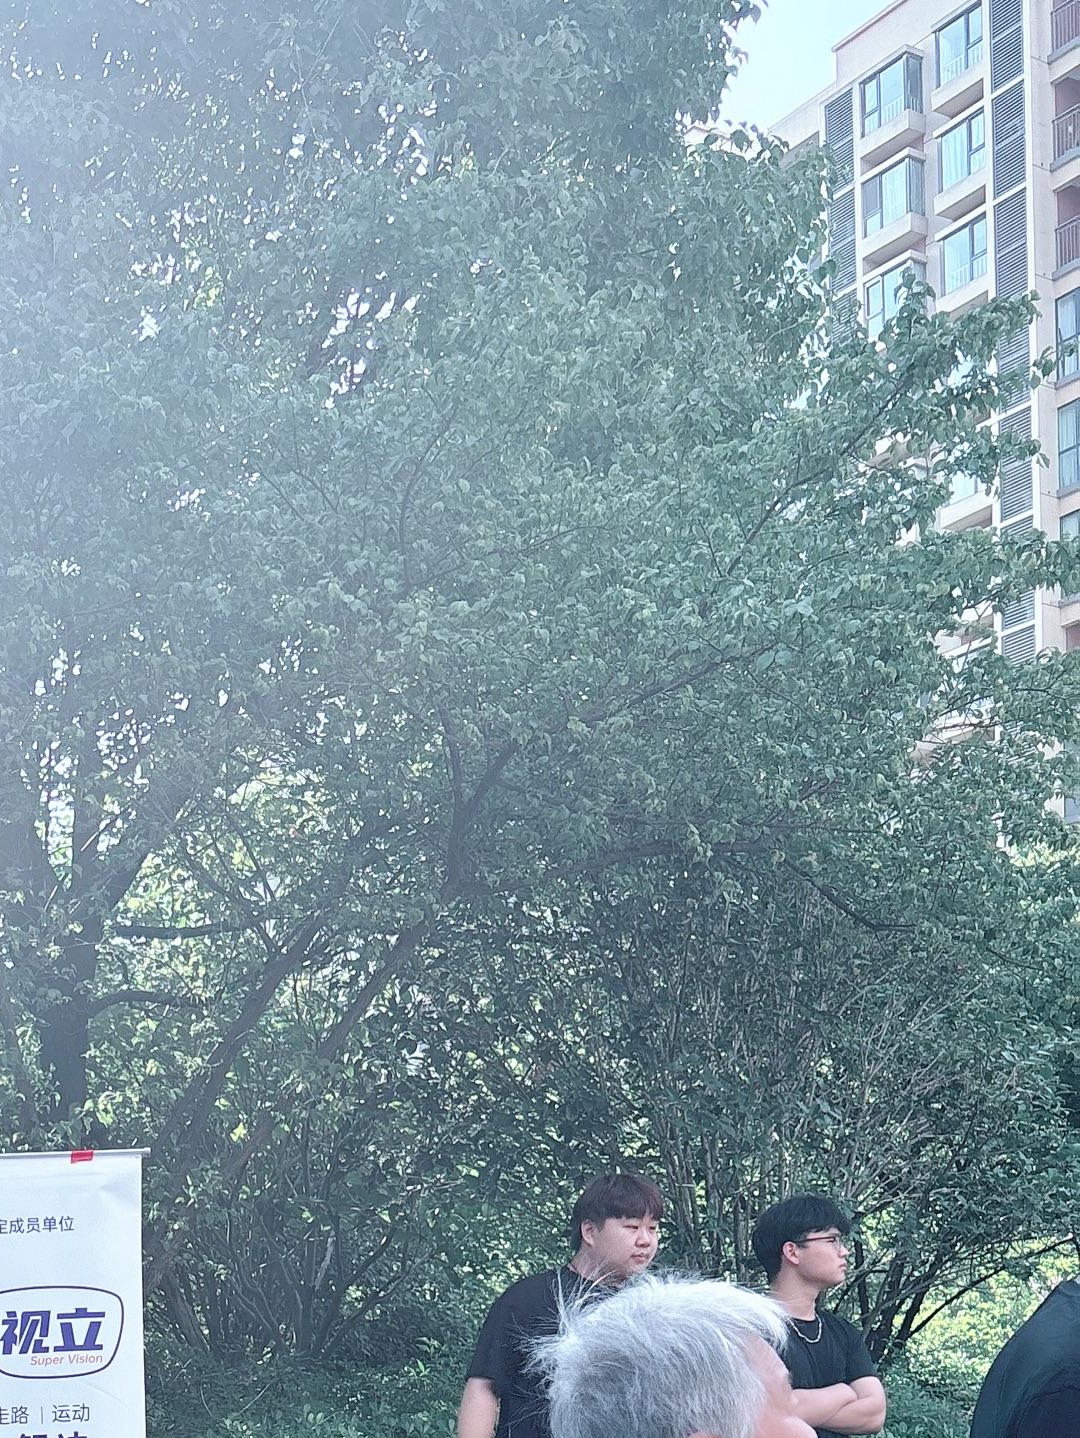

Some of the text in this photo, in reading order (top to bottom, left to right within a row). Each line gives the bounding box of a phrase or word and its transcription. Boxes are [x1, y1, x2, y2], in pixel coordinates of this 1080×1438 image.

[29, 1350, 105, 1370] Super Vision
[51, 1402, 90, 1423] 运动
